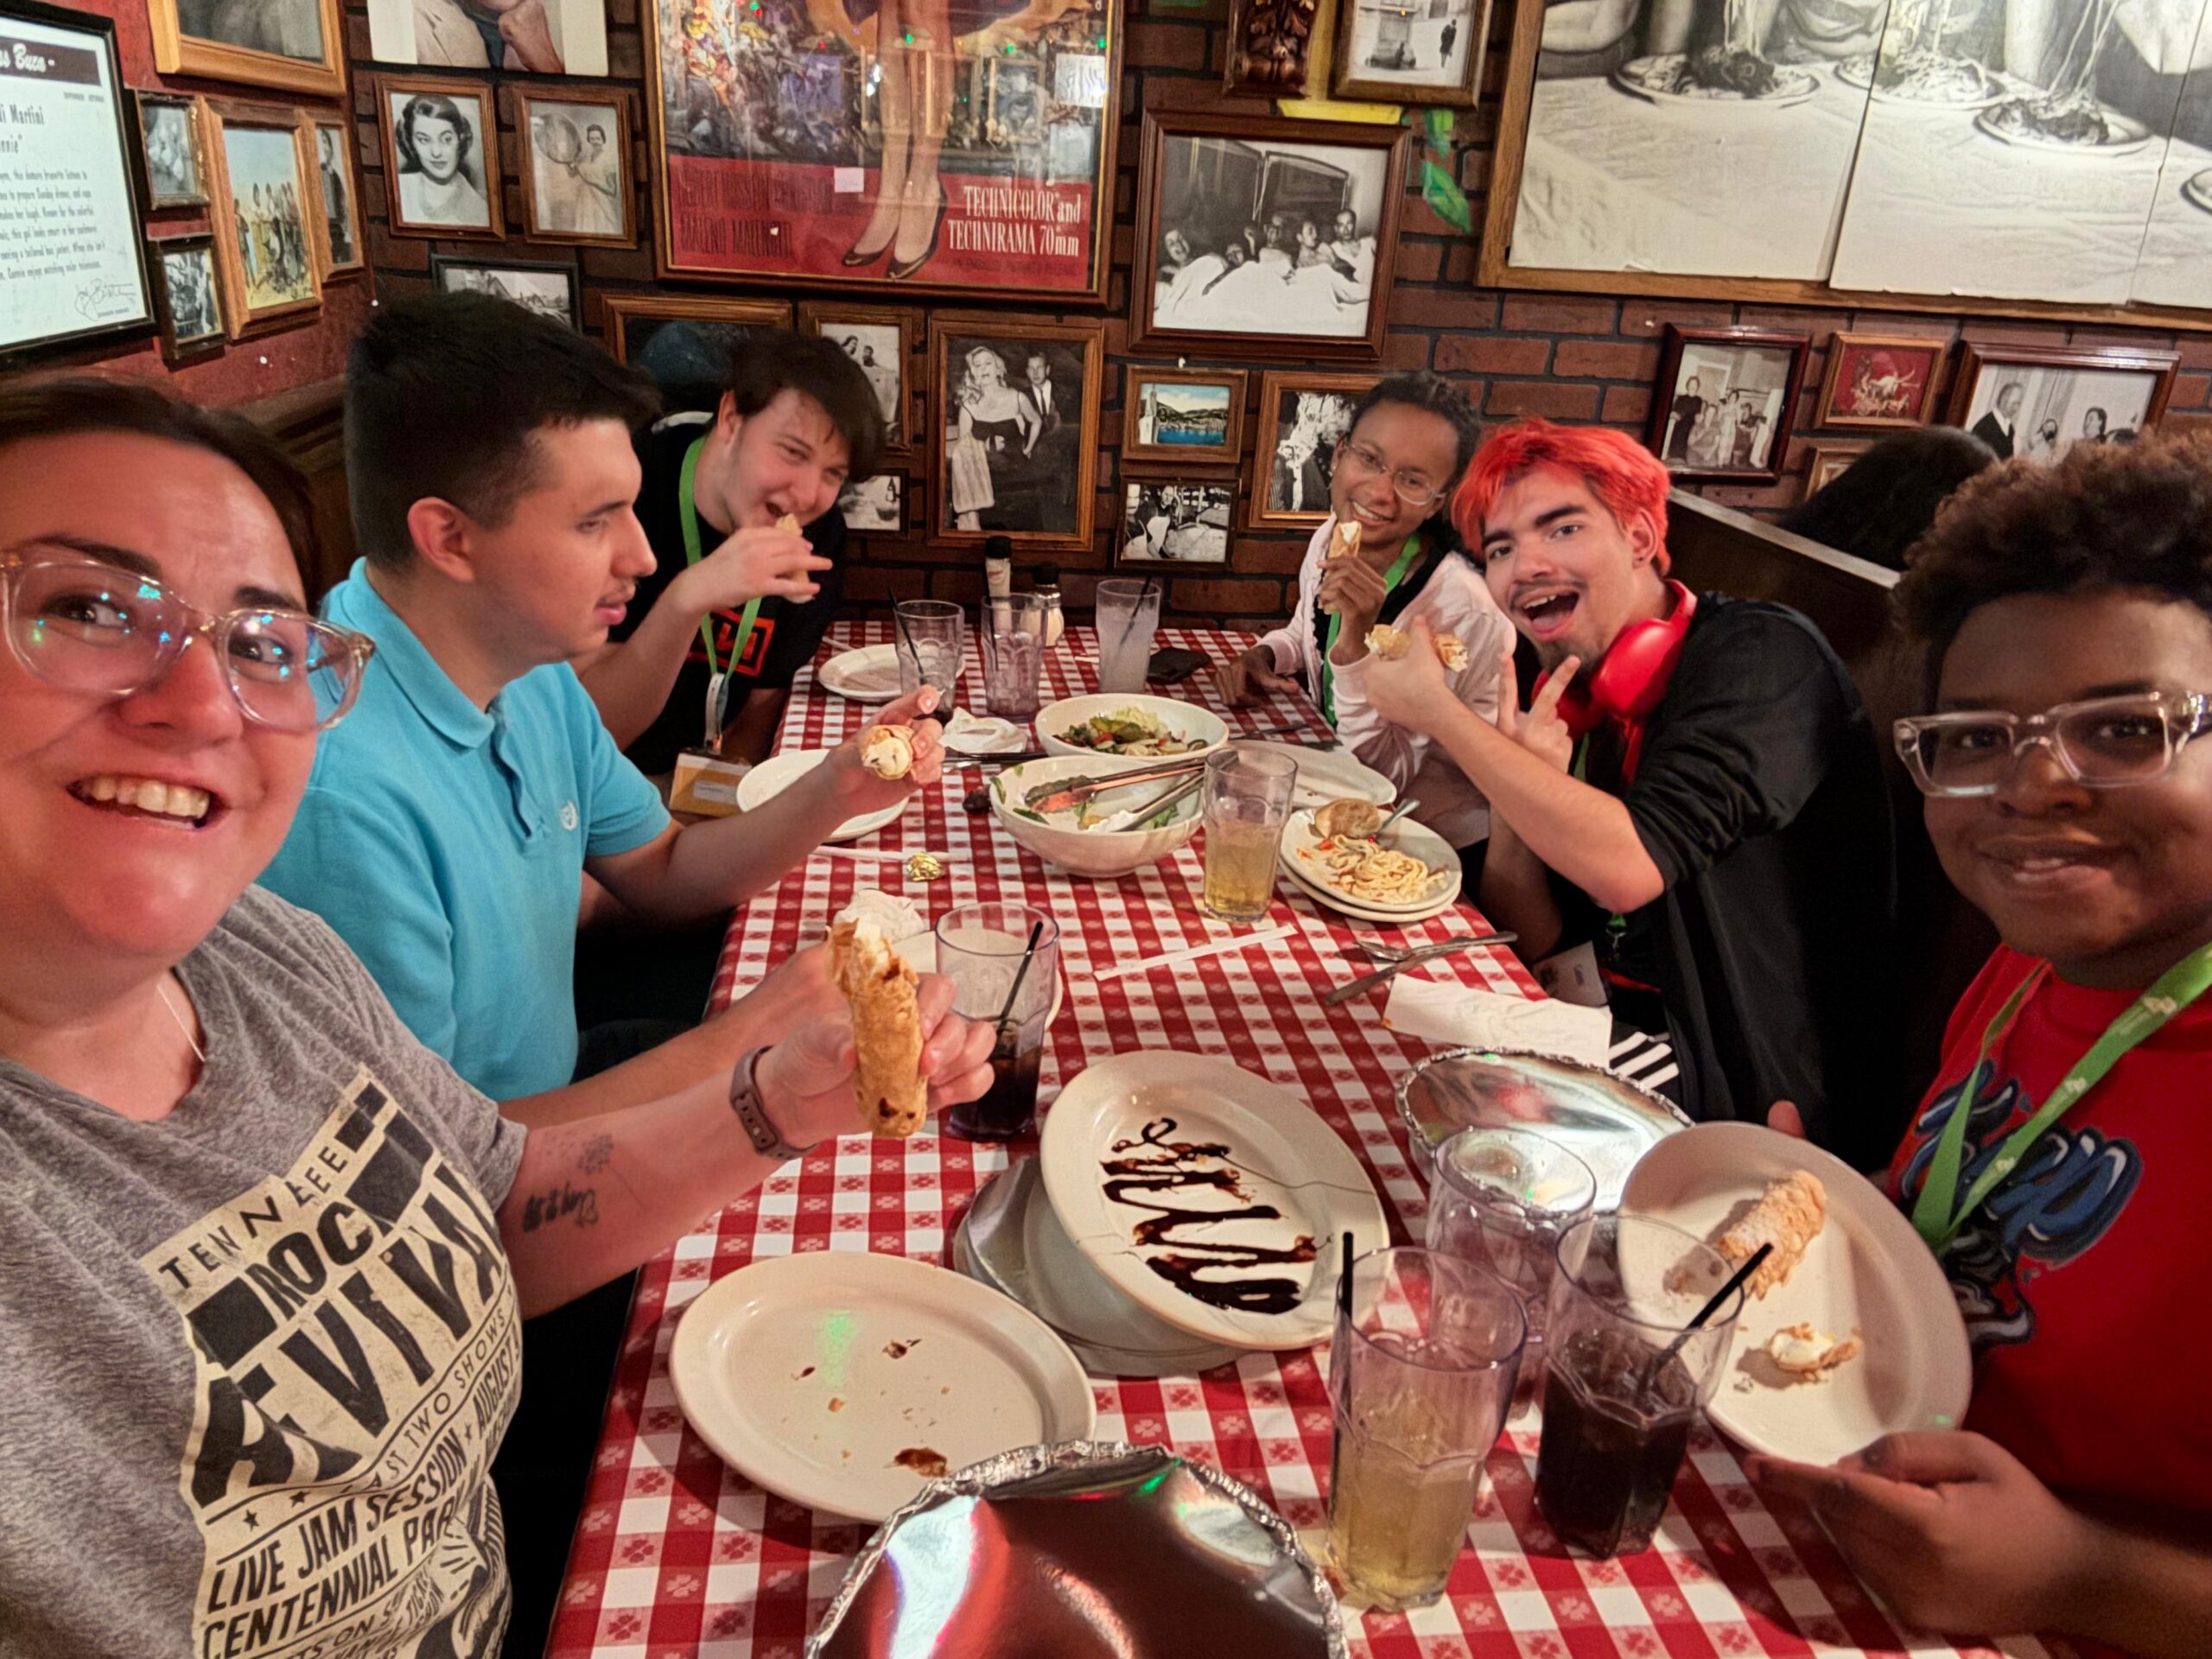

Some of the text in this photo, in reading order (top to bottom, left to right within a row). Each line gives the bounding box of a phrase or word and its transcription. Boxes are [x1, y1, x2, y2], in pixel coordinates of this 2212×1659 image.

[10, 104, 45, 125] Martini
[948, 219, 1080, 257] TECHNIRAMA 70mm
[963, 185, 1082, 224] TECHNICOLOR and
[245, 1202, 395, 1322] ROC
[404, 1392, 451, 1449] TWO
[454, 1307, 505, 1389] SHOWS
[202, 1535, 399, 1659] CENTENNIAL
[403, 1488, 462, 1567] PAR
[207, 1539, 286, 1615] LIVE
[297, 1497, 359, 1580] JAM
[365, 1427, 467, 1533] SESSION
